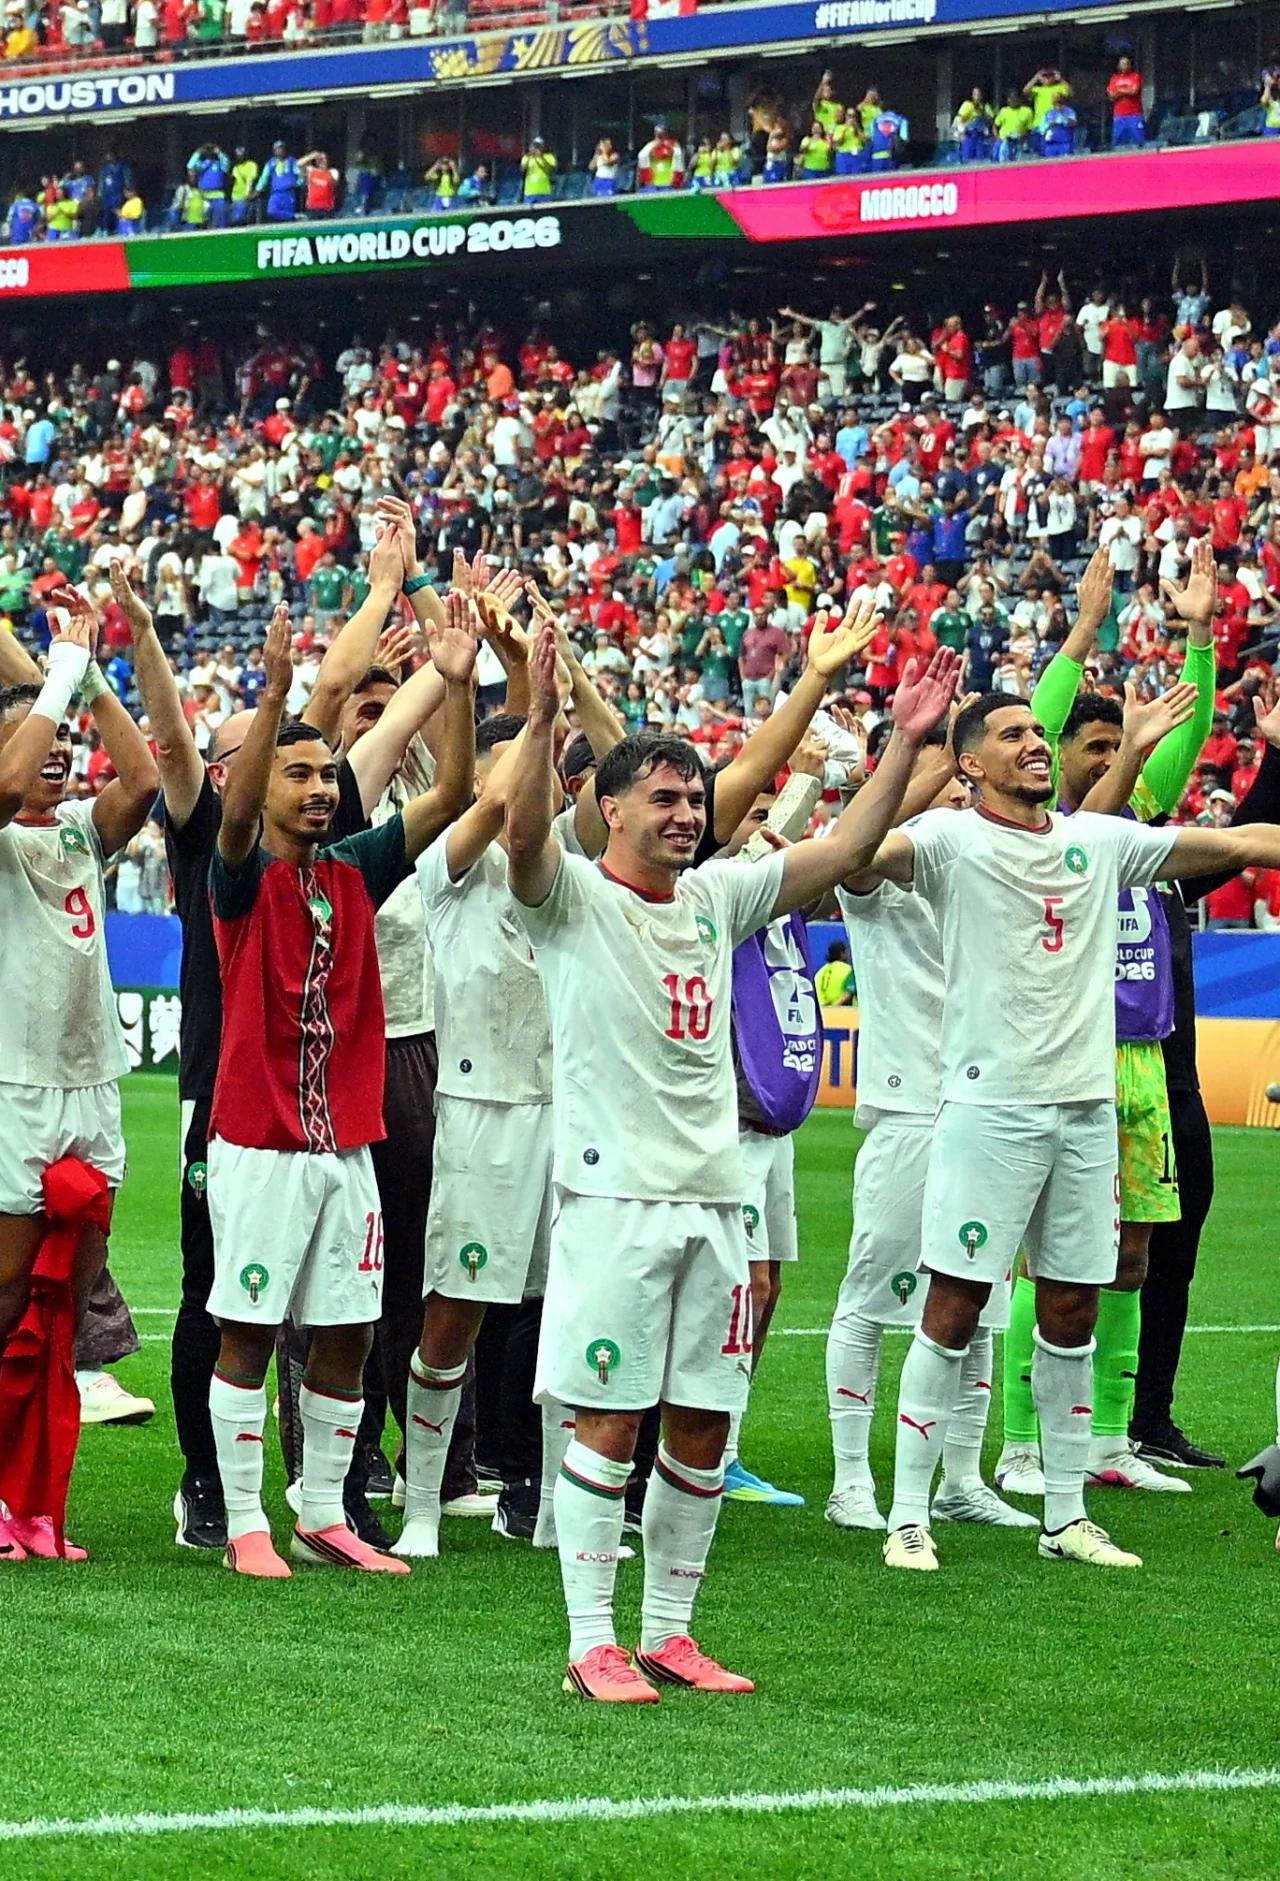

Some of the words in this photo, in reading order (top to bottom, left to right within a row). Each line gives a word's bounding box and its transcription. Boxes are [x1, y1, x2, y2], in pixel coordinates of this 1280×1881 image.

[860, 182, 958, 222] MOROCCO
[257, 237, 314, 269] FIFA
[316, 230, 410, 264] WORLD
[412, 224, 466, 257] CUP
[467, 216, 561, 252] 2026
[65, 886, 95, 939] 9
[1042, 898, 1063, 952] 5
[1118, 918, 1138, 931] IFA
[1135, 948, 1155, 960] CUP
[662, 974, 712, 1039] 10
